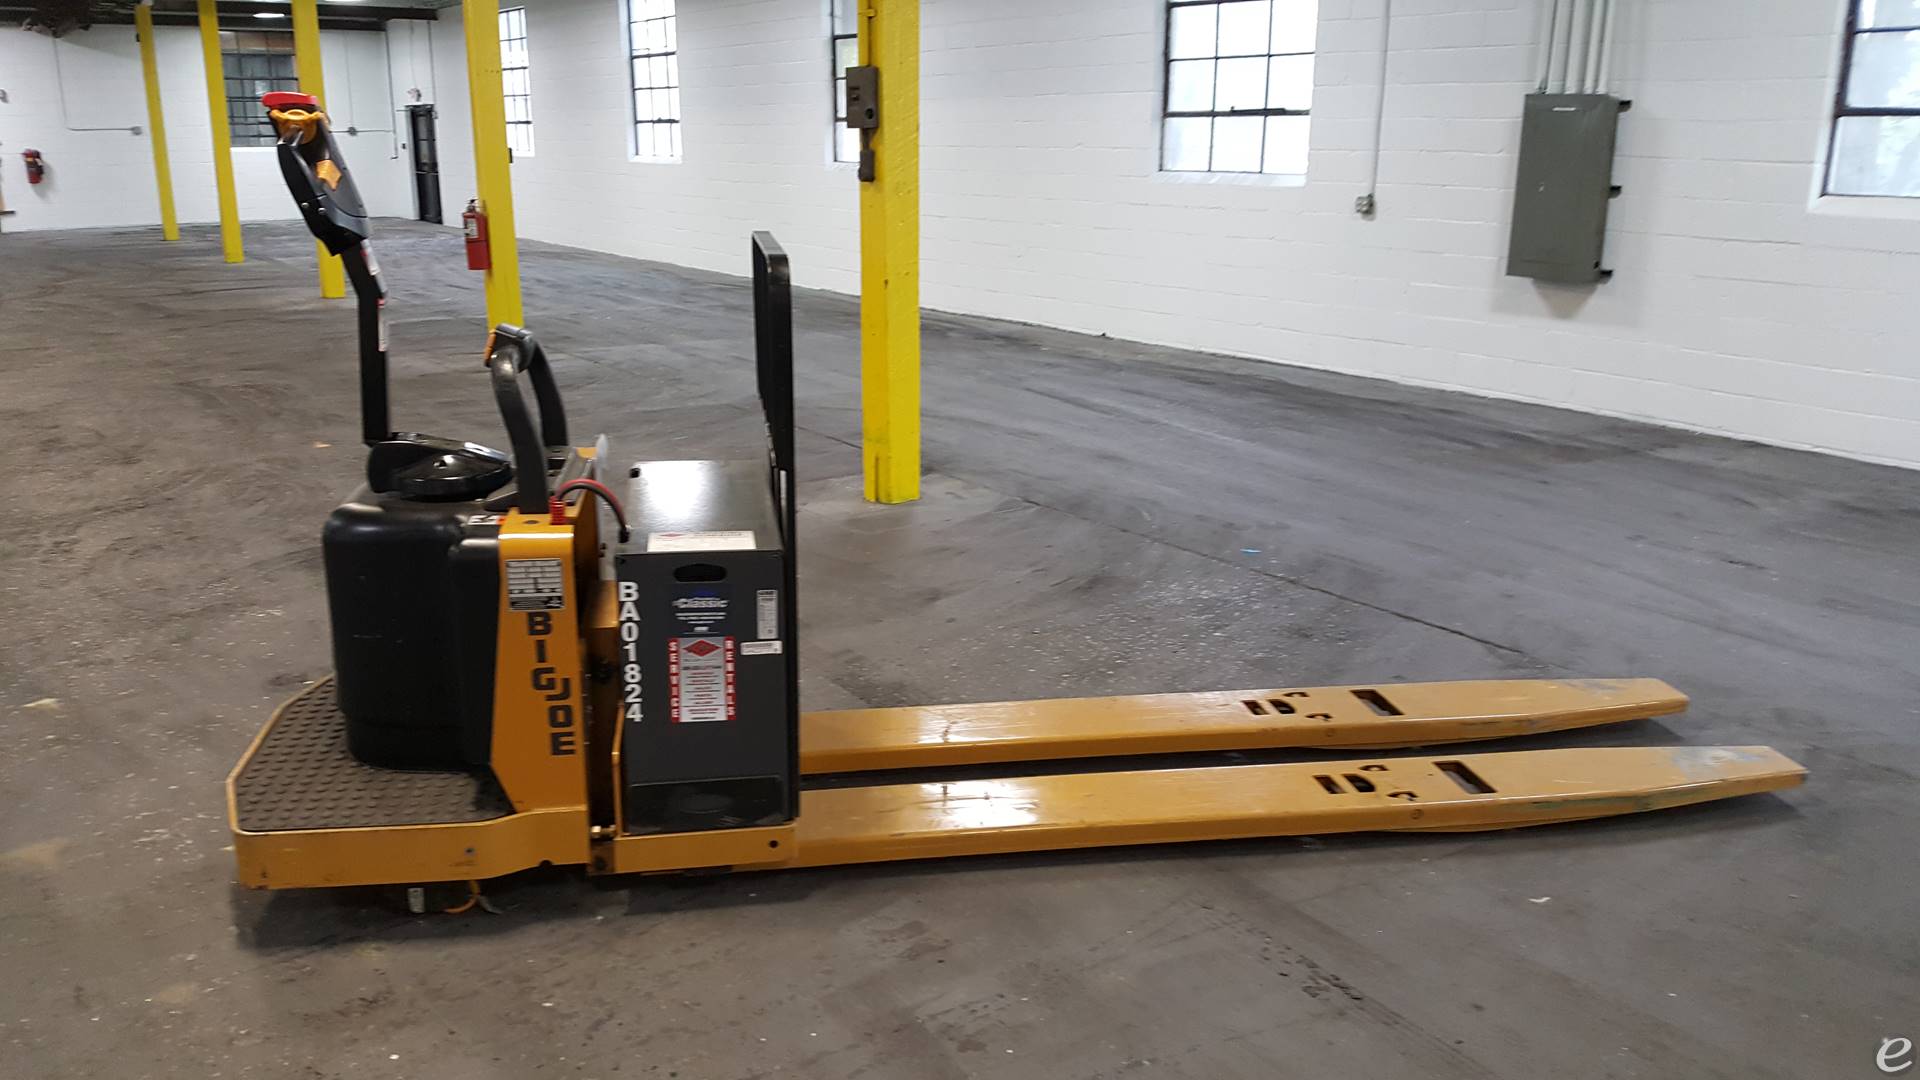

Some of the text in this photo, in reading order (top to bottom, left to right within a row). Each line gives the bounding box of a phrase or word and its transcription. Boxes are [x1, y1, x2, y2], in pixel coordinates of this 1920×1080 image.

[618, 581, 644, 722] BA01824
[668, 641, 680, 718] SERVICE
[725, 640, 736, 716] RENTALS
